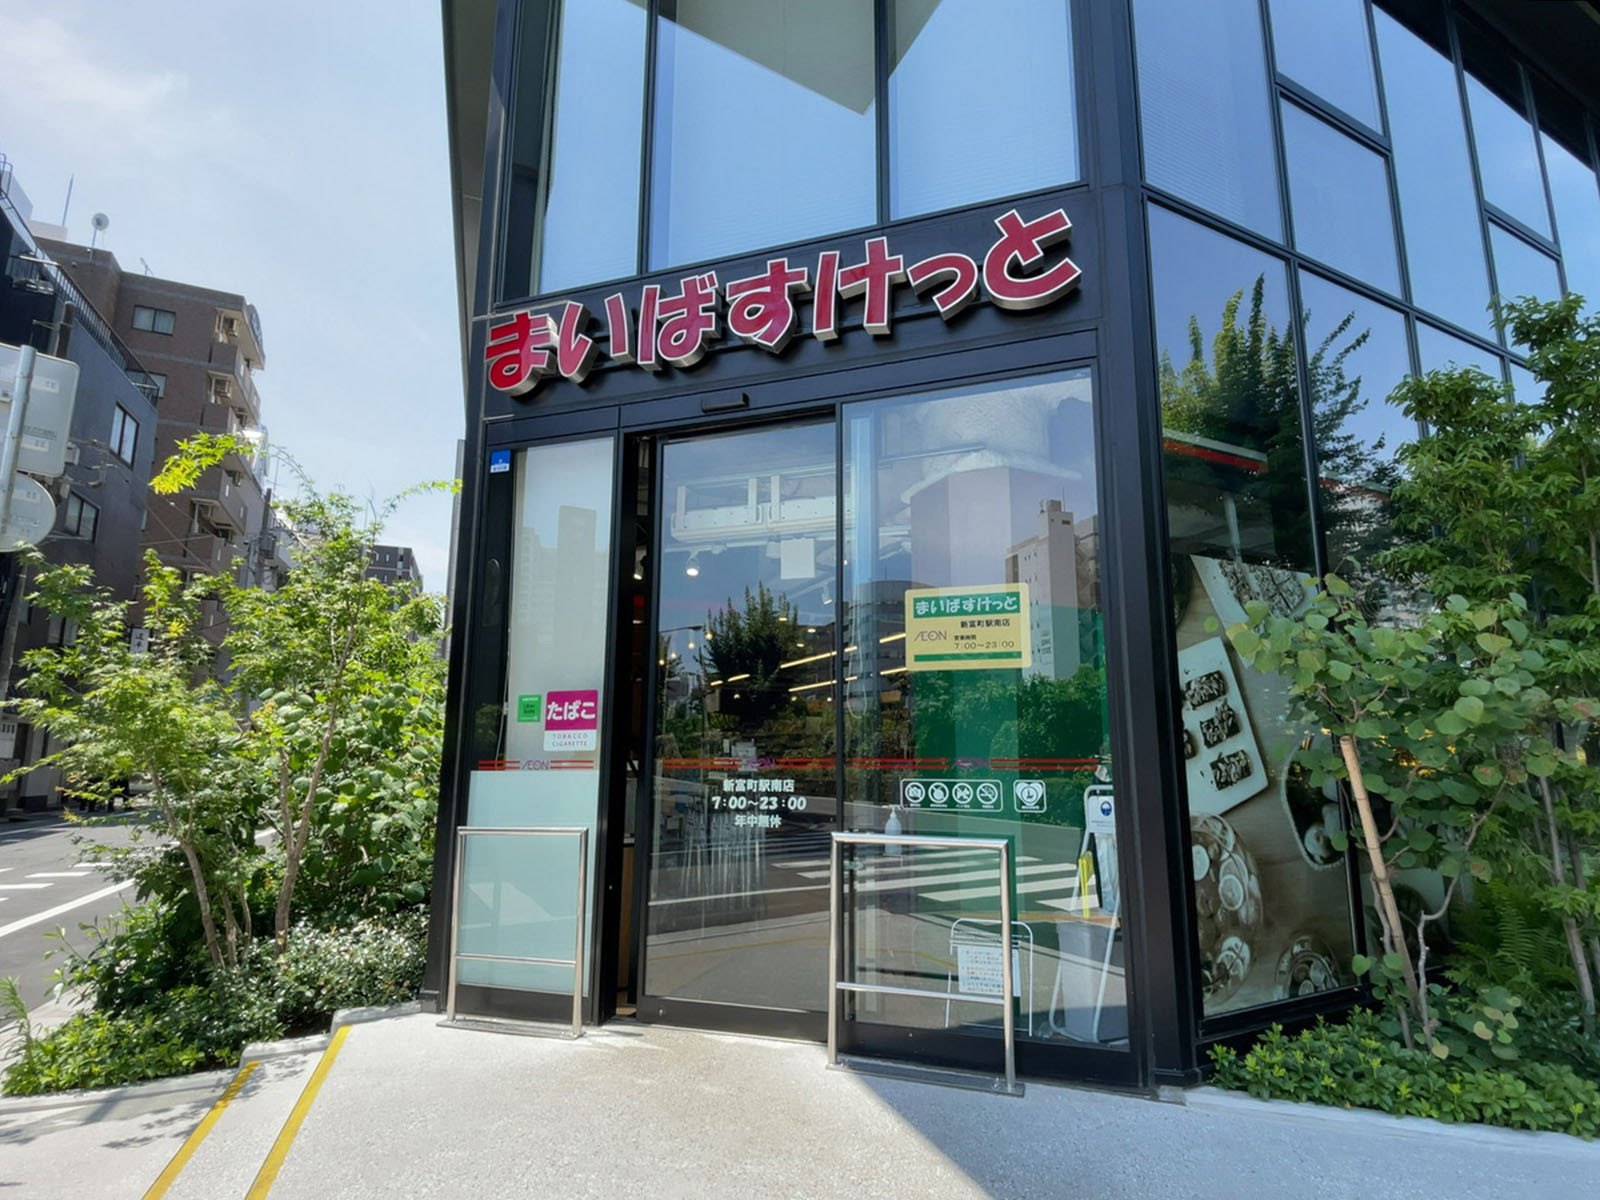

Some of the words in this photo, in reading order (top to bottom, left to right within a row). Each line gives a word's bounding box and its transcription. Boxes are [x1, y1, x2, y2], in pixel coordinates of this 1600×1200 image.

[485, 208, 1083, 392] まいばすけっと
[915, 596, 1018, 616] まいばすけっと
[960, 618, 1011, 629] 新富町駅南店
[546, 699, 596, 721] たばこ
[552, 732, 588, 740] TOBACCO
[723, 778, 795, 792] 新富町駅南店
[734, 814, 782, 829] 年中無休
